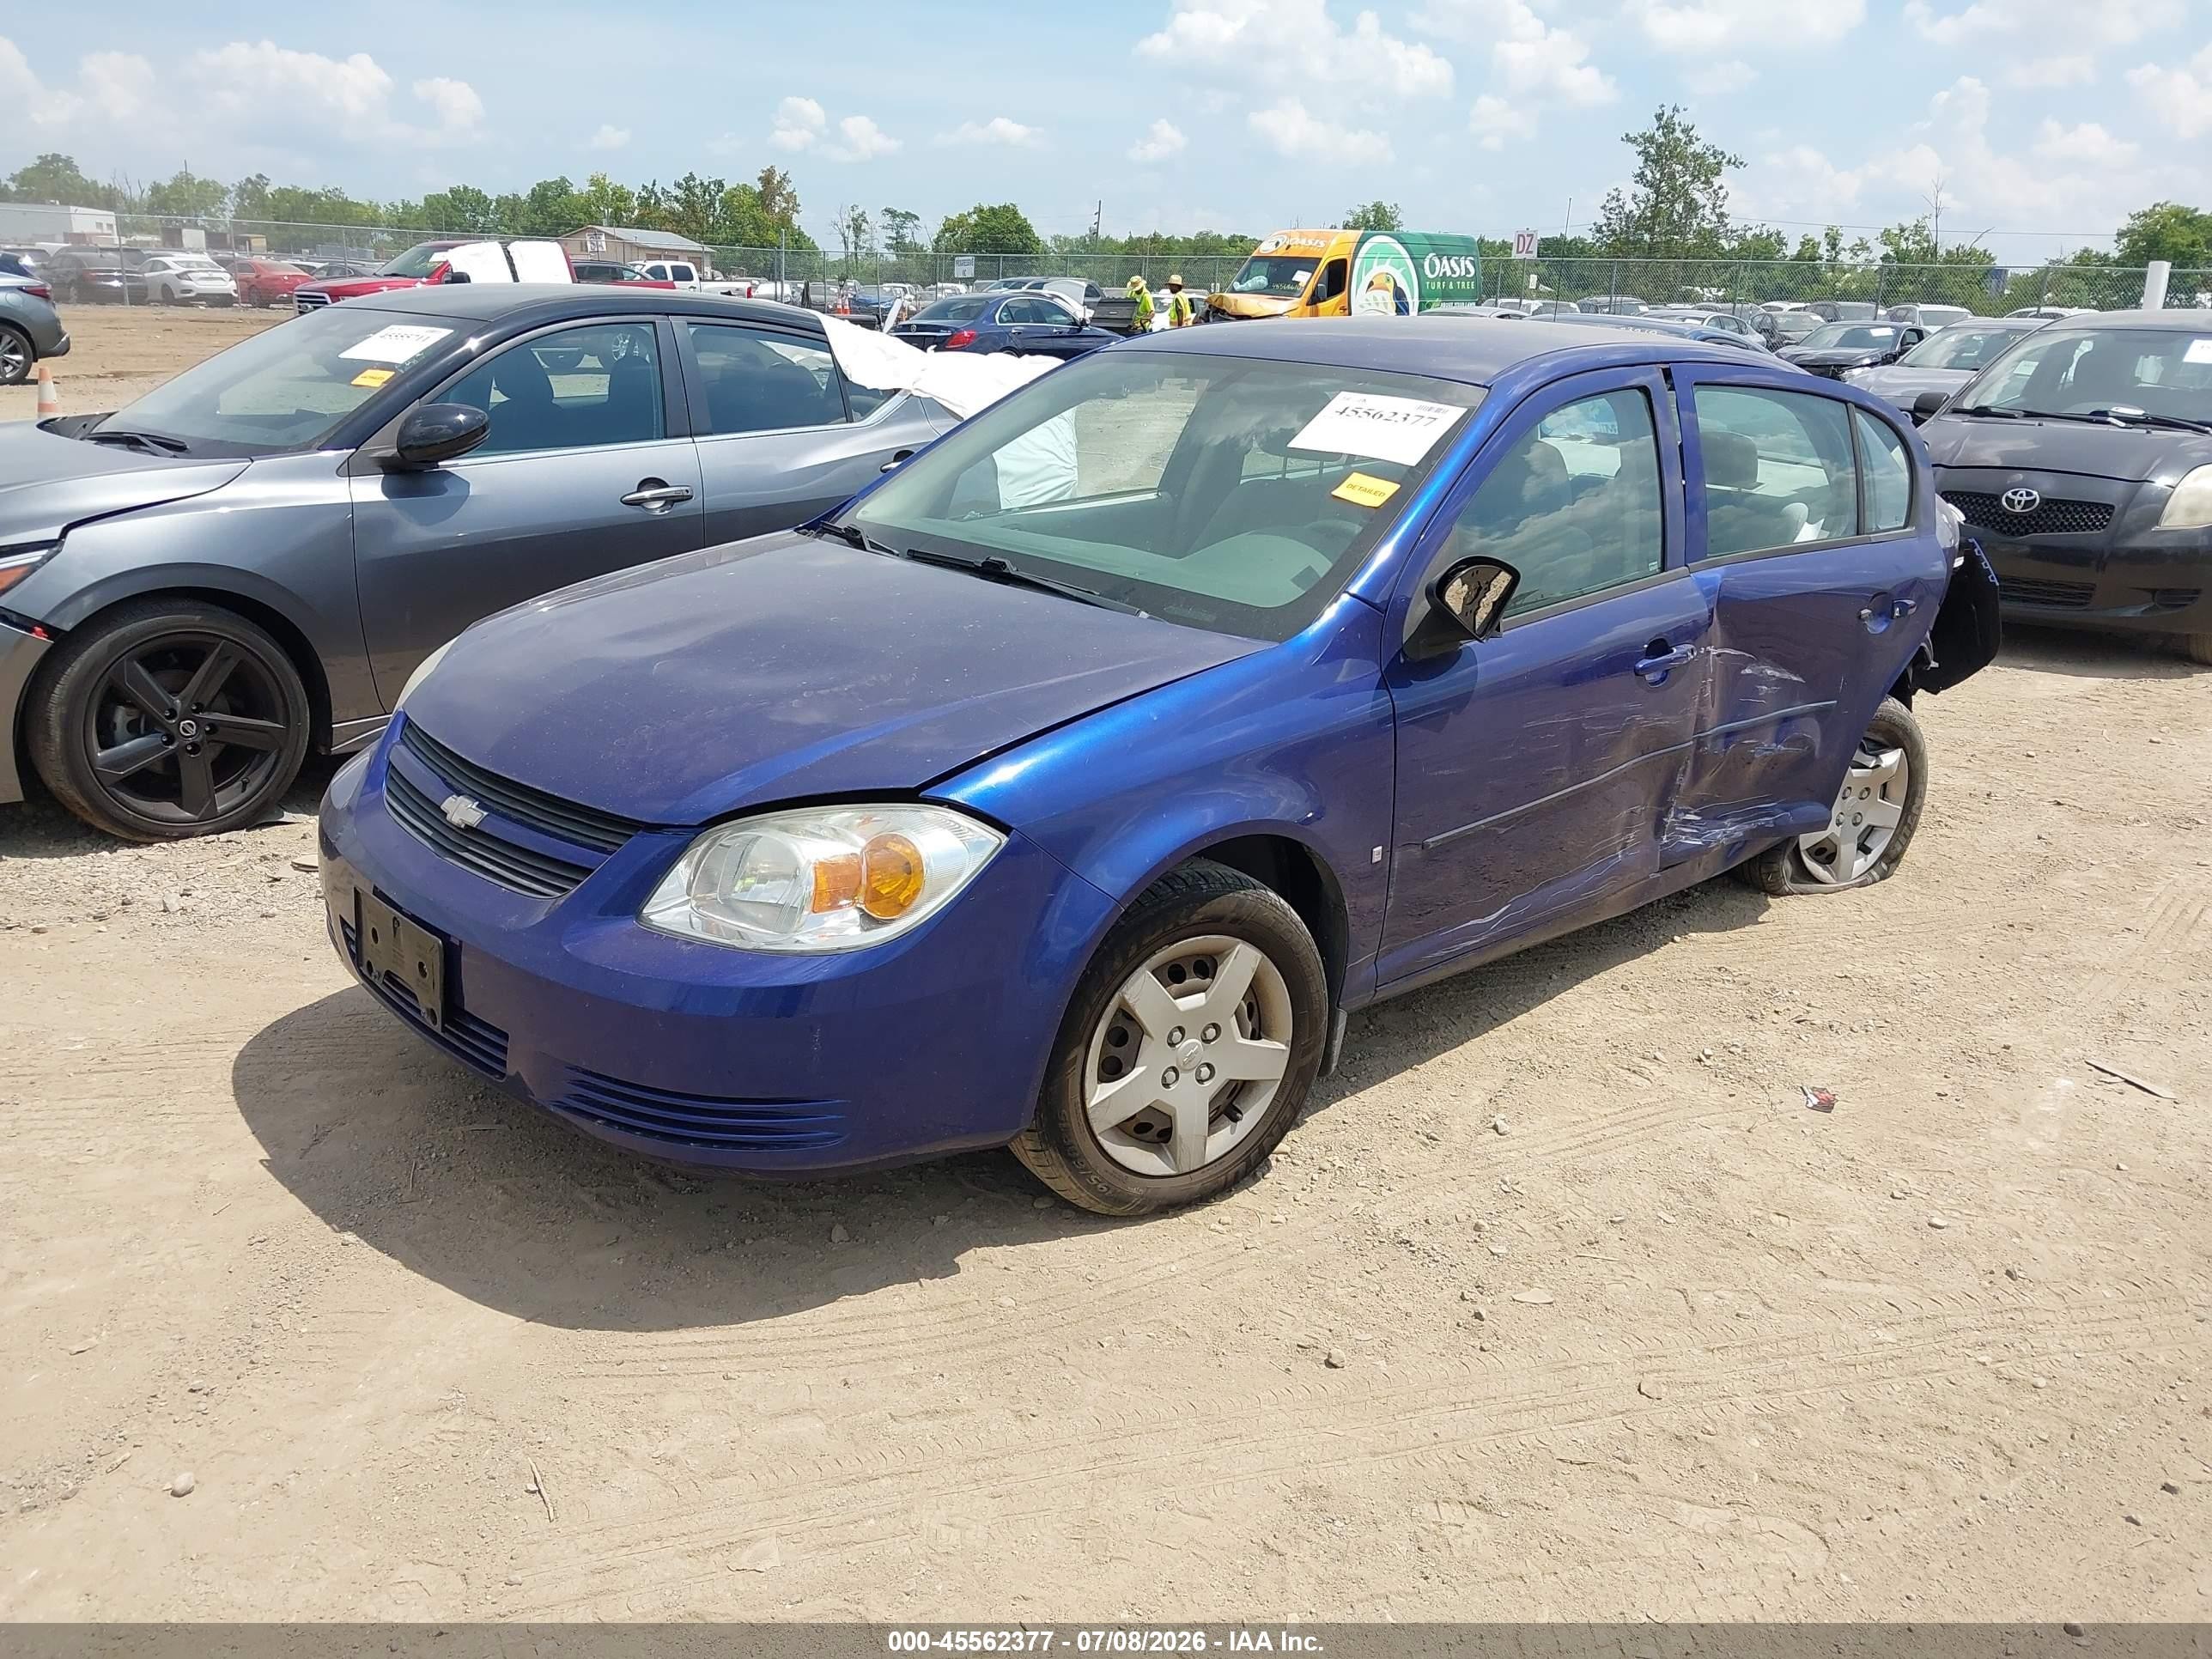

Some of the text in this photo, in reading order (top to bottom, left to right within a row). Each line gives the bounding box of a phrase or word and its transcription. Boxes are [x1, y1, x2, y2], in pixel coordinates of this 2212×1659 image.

[1516, 234, 1534, 255] DZ
[1424, 252, 1475, 278] OASIS
[1425, 281, 1446, 289] TURF
[1335, 406, 1438, 427] 45562377
[1346, 483, 1386, 497] DETAILED
